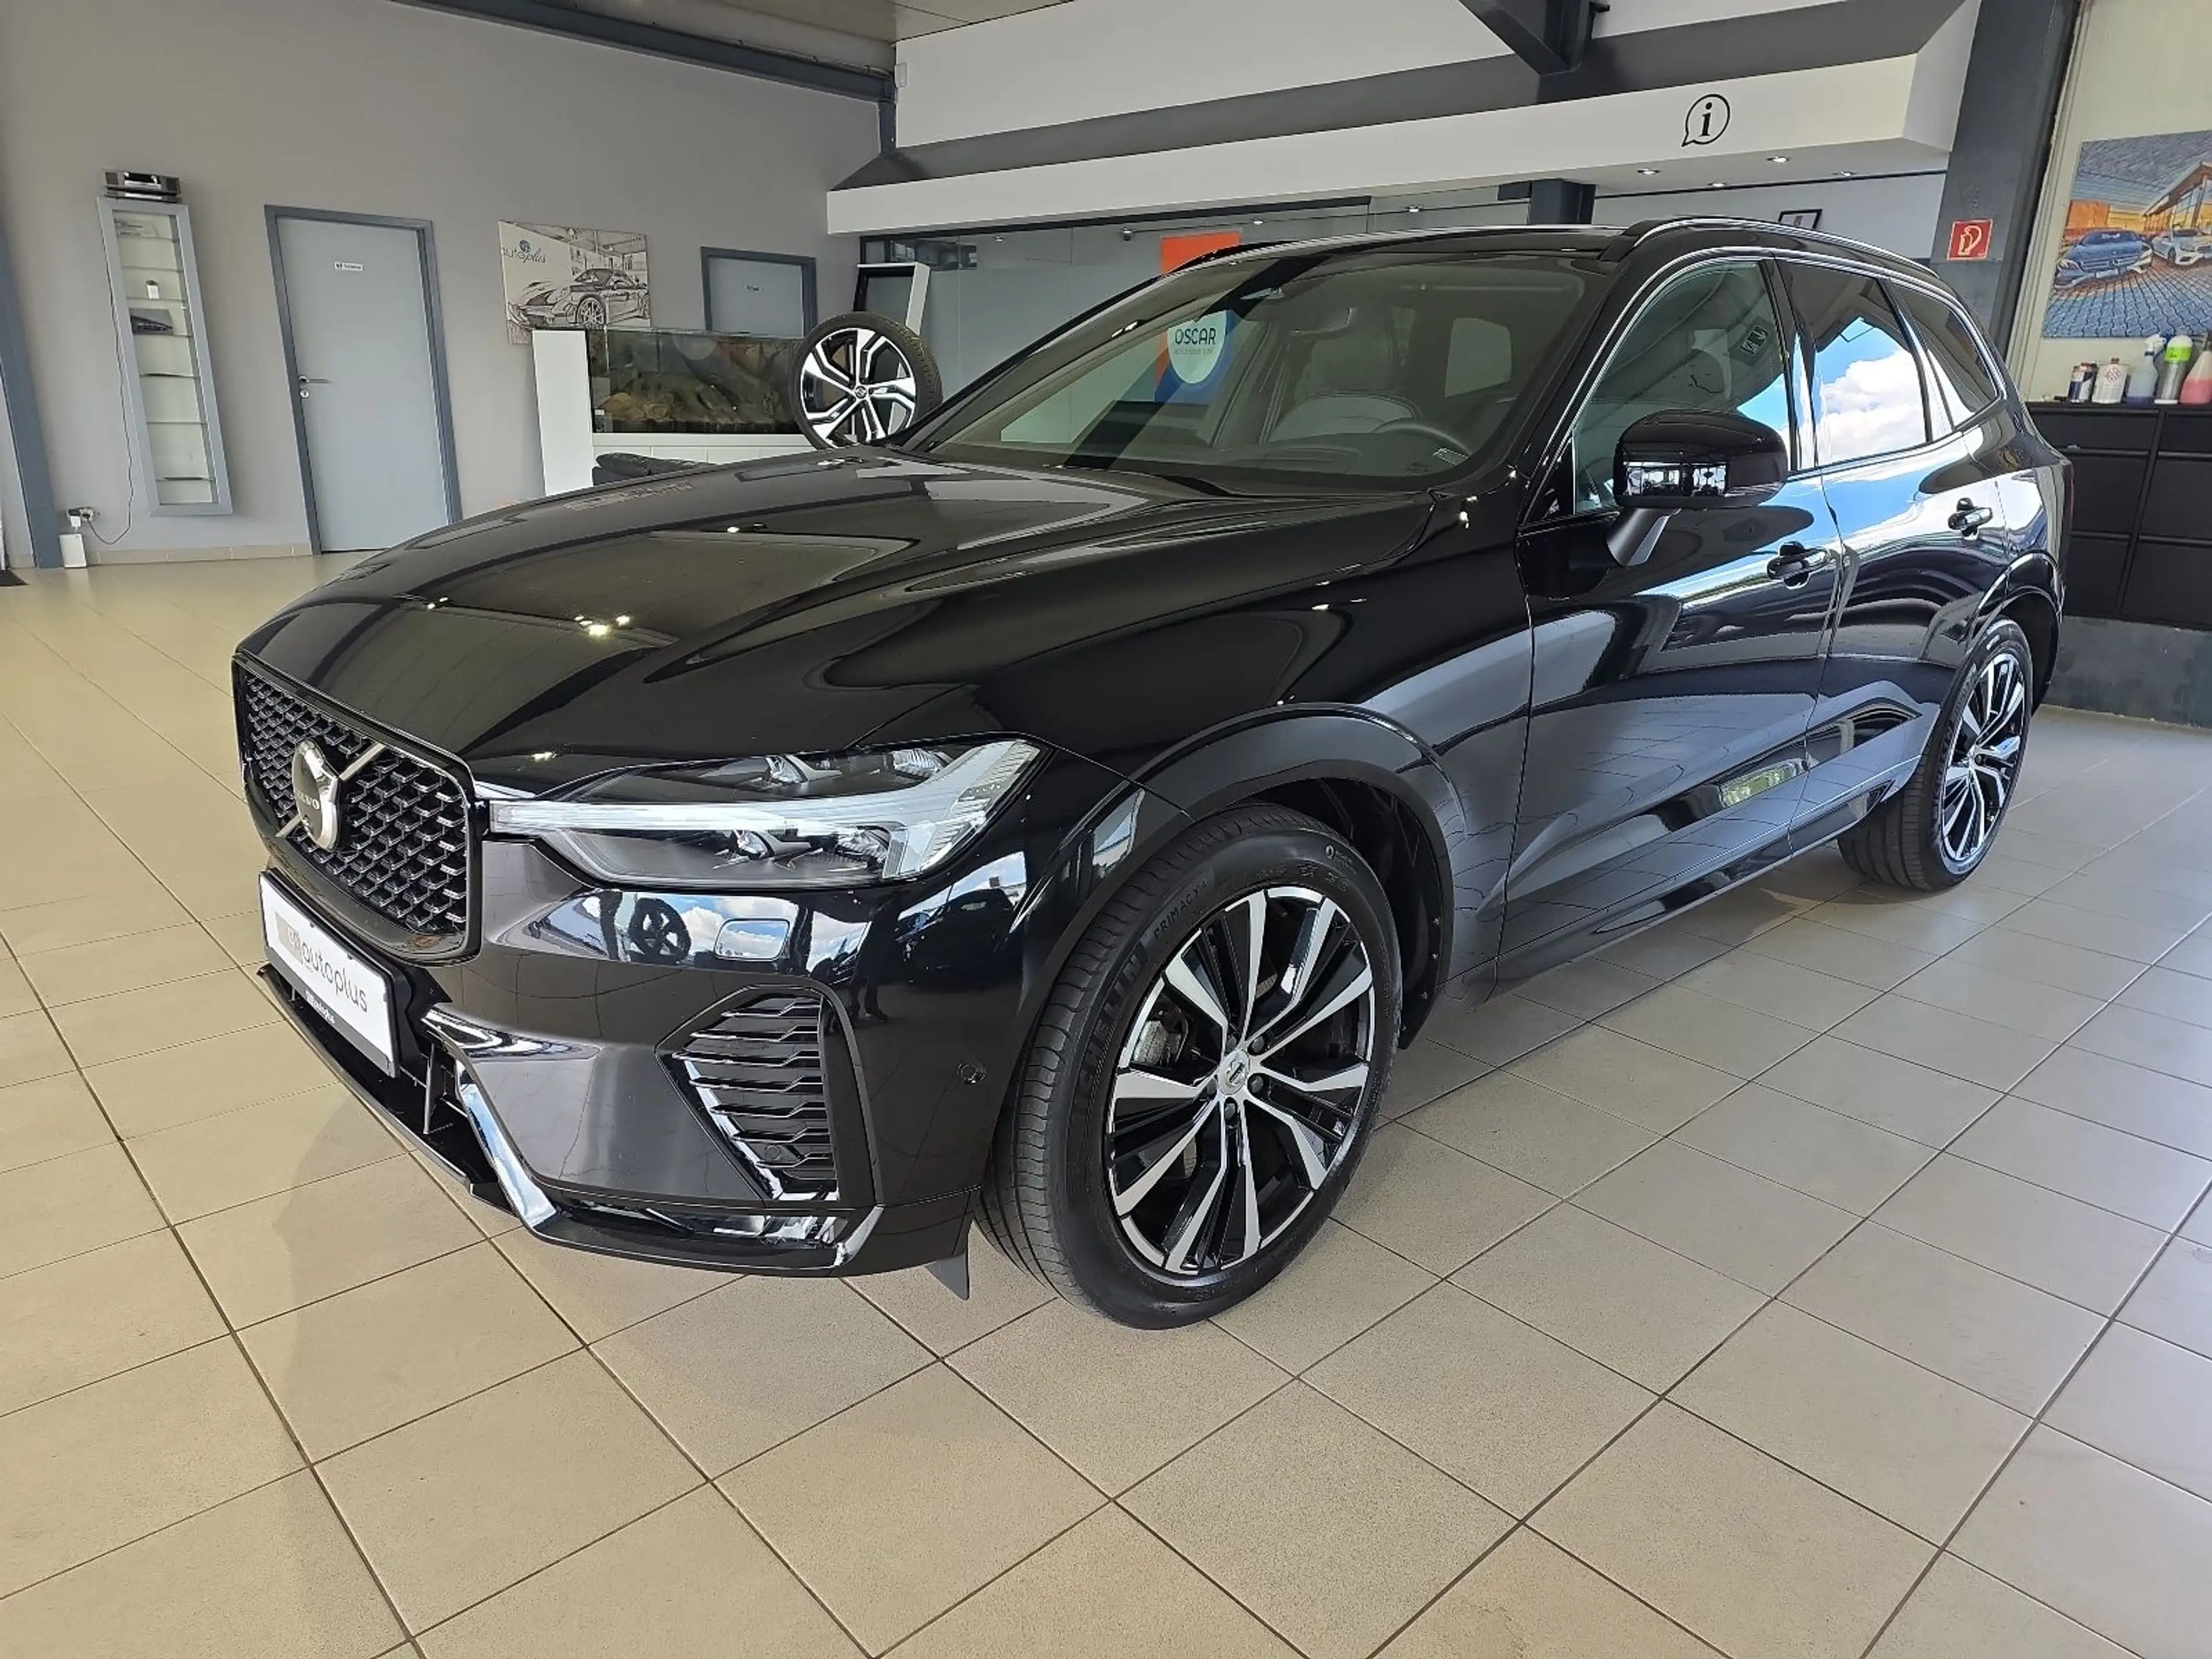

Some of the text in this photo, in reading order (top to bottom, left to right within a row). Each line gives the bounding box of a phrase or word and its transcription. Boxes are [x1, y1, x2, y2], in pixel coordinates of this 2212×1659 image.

[1175, 328, 1216, 345] OSCAR
[1154, 883, 1200, 939] PRIMACY
[301, 942, 368, 1013] autoplus
